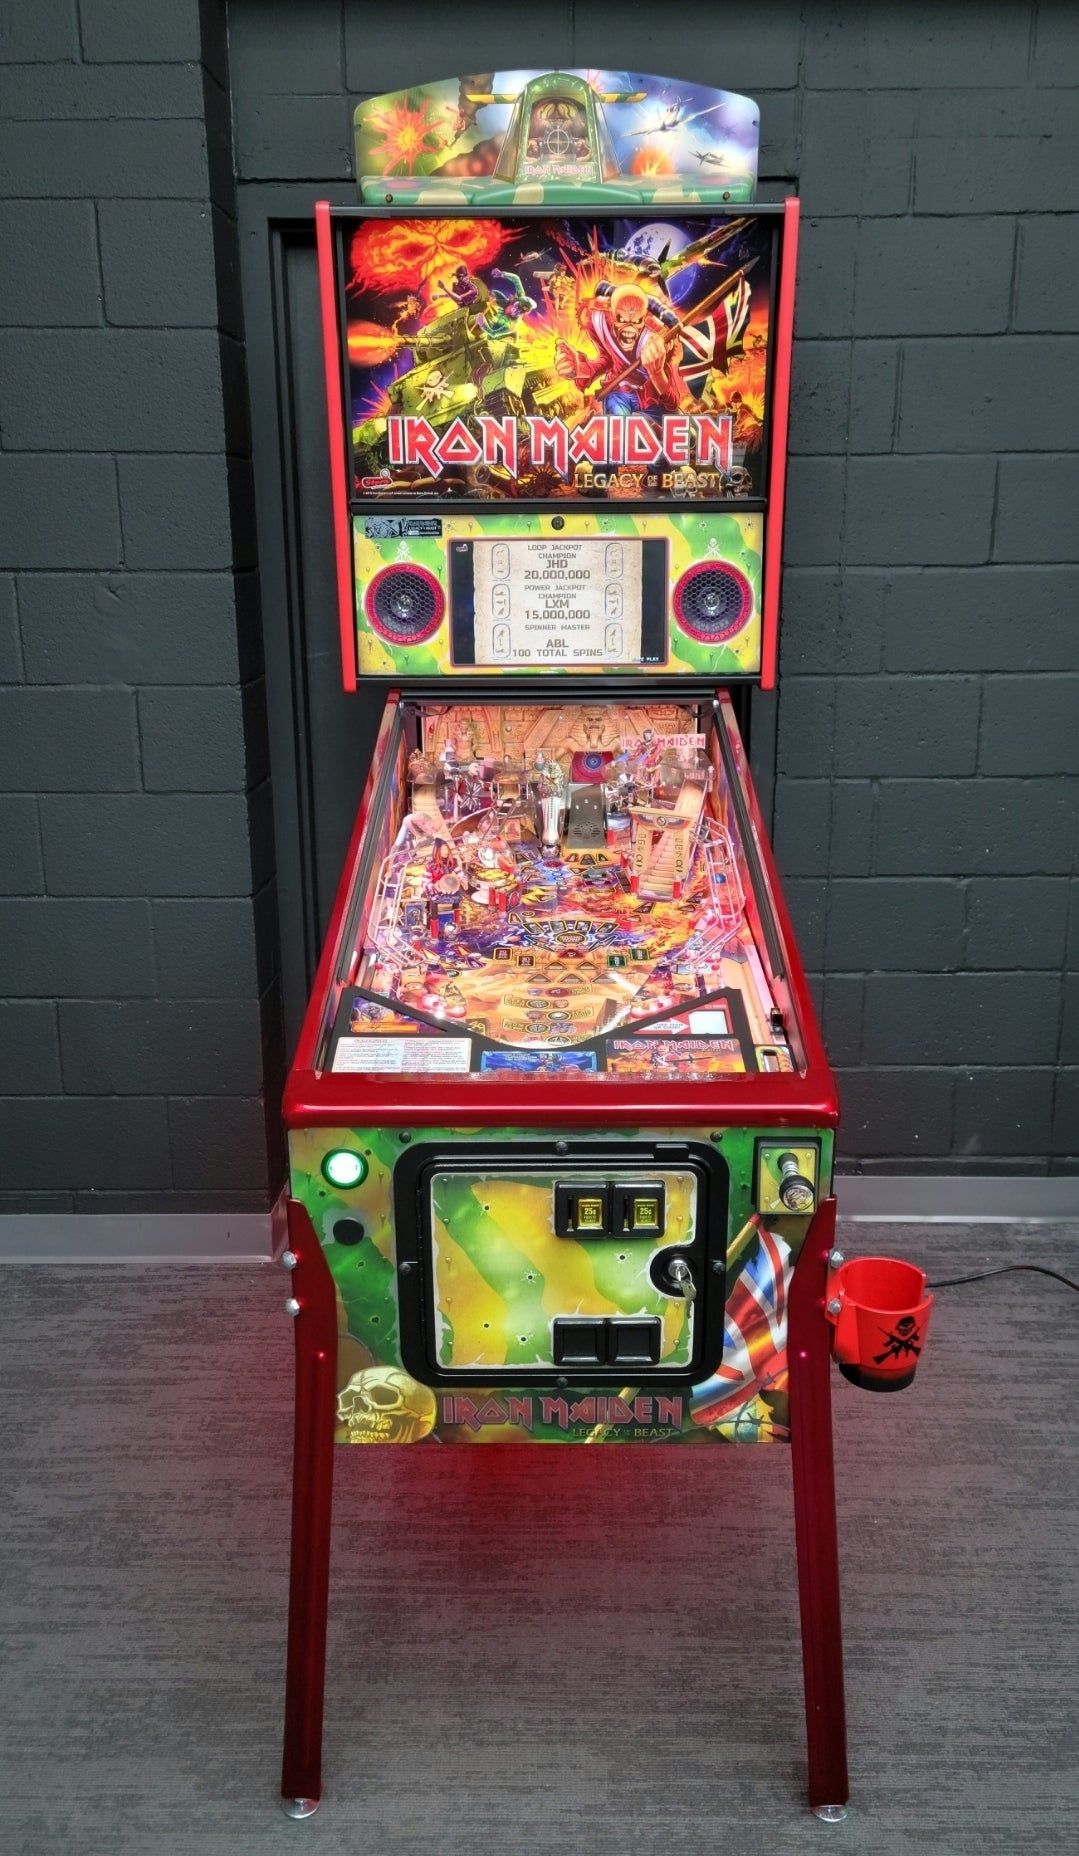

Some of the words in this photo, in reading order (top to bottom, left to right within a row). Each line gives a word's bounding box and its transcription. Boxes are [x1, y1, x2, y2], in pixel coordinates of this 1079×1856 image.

[388, 415, 518, 480] IRON
[525, 415, 733, 482] MAIDEN
[574, 473, 645, 489] LEGACY
[662, 472, 720, 489] BEAST
[546, 559, 568, 569] JHD
[524, 570, 591, 580] 20,000,000
[545, 600, 569, 609] LXM
[525, 610, 591, 620] 15,000,000
[546, 639, 569, 648] ABL
[512, 649, 531, 657] 100
[537, 649, 567, 657] TOTAL
[573, 649, 603, 657] SPINS
[613, 1039, 657, 1051] IRON
[662, 1039, 735, 1051] MAIDEN
[443, 1396, 533, 1432] IRON
[538, 1396, 682, 1432] MAIDEN
[573, 1428, 621, 1437] LEGACY
[634, 1428, 674, 1437] BEAST
